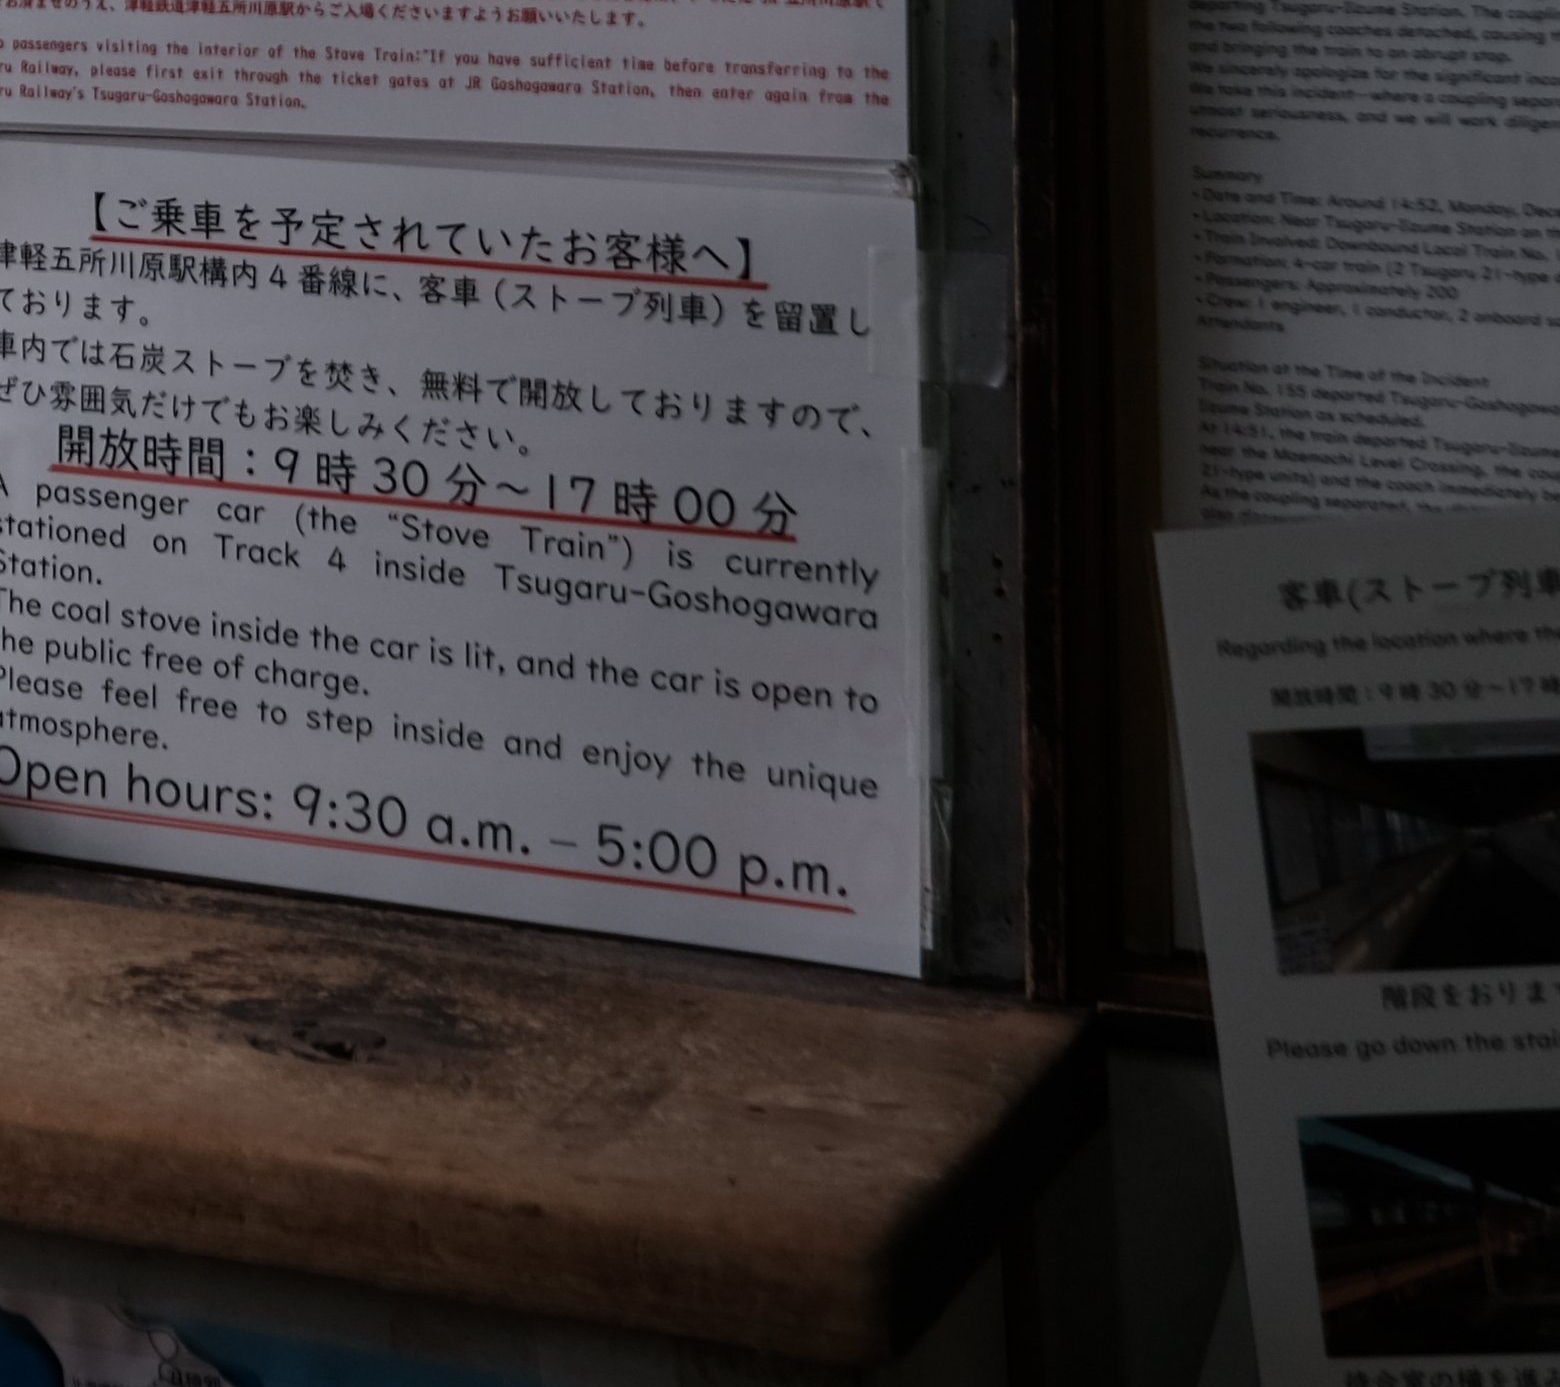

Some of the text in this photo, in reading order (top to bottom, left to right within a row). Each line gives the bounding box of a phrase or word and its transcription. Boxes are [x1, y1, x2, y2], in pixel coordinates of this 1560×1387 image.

[84, 192, 755, 281] 【ご乗車を予定されていたお客様へ】
[127, 760, 273, 819] hours:
[291, 784, 408, 837] 9:30
[426, 809, 531, 856] a.m.
[596, 823, 718, 879] 5:00
[740, 852, 850, 898] p.m.
